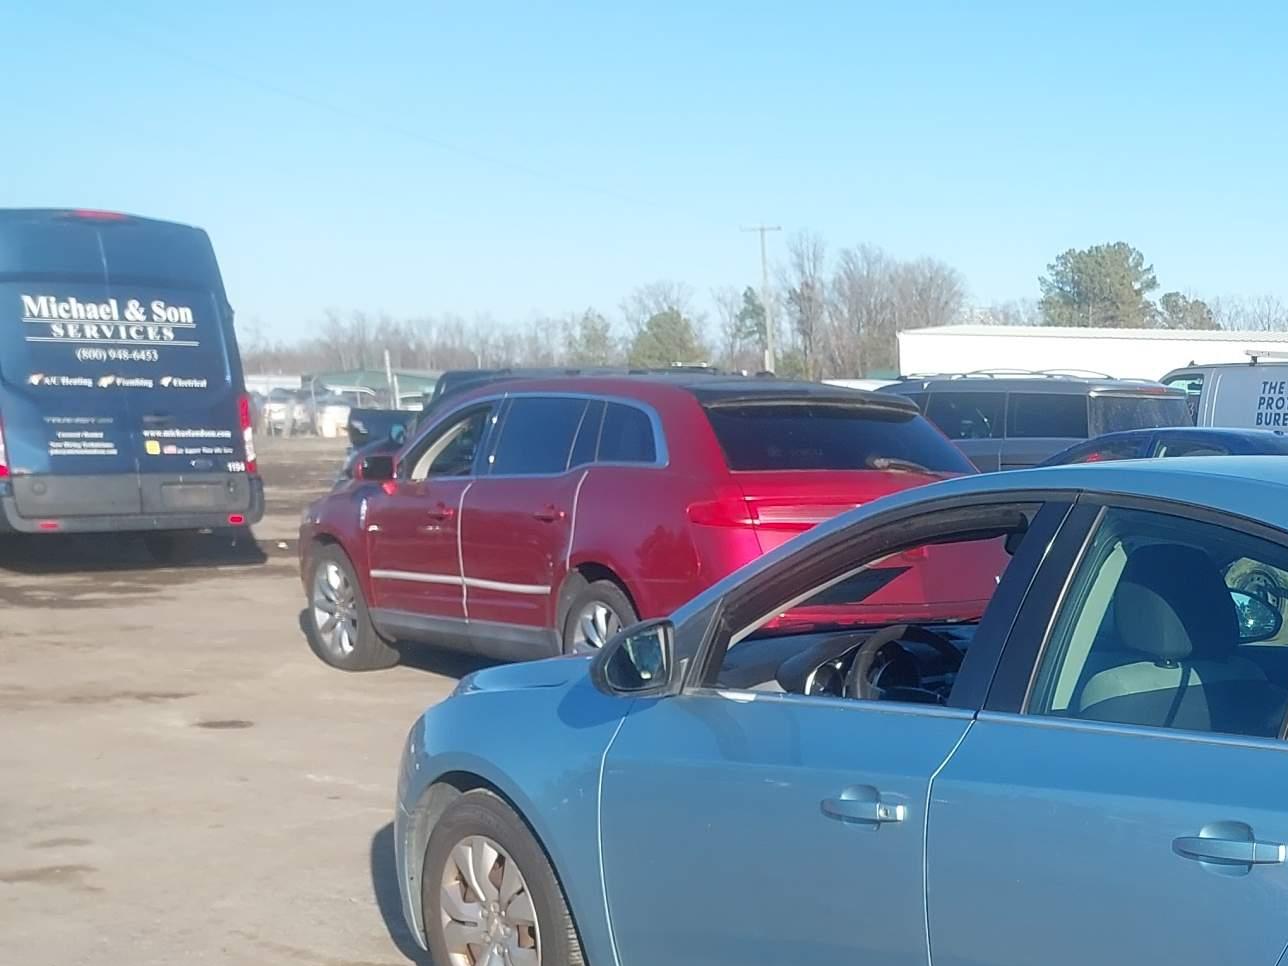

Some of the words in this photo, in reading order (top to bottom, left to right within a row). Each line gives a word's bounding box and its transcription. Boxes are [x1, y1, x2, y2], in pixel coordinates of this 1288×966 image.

[22, 295, 118, 321] Michael
[125, 299, 147, 322] &
[151, 301, 194, 323] Son
[51, 324, 175, 341] SERVICES
[76, 348, 107, 362] (800)
[172, 378, 207, 388] Electrical
[1261, 381, 1285, 395] THE
